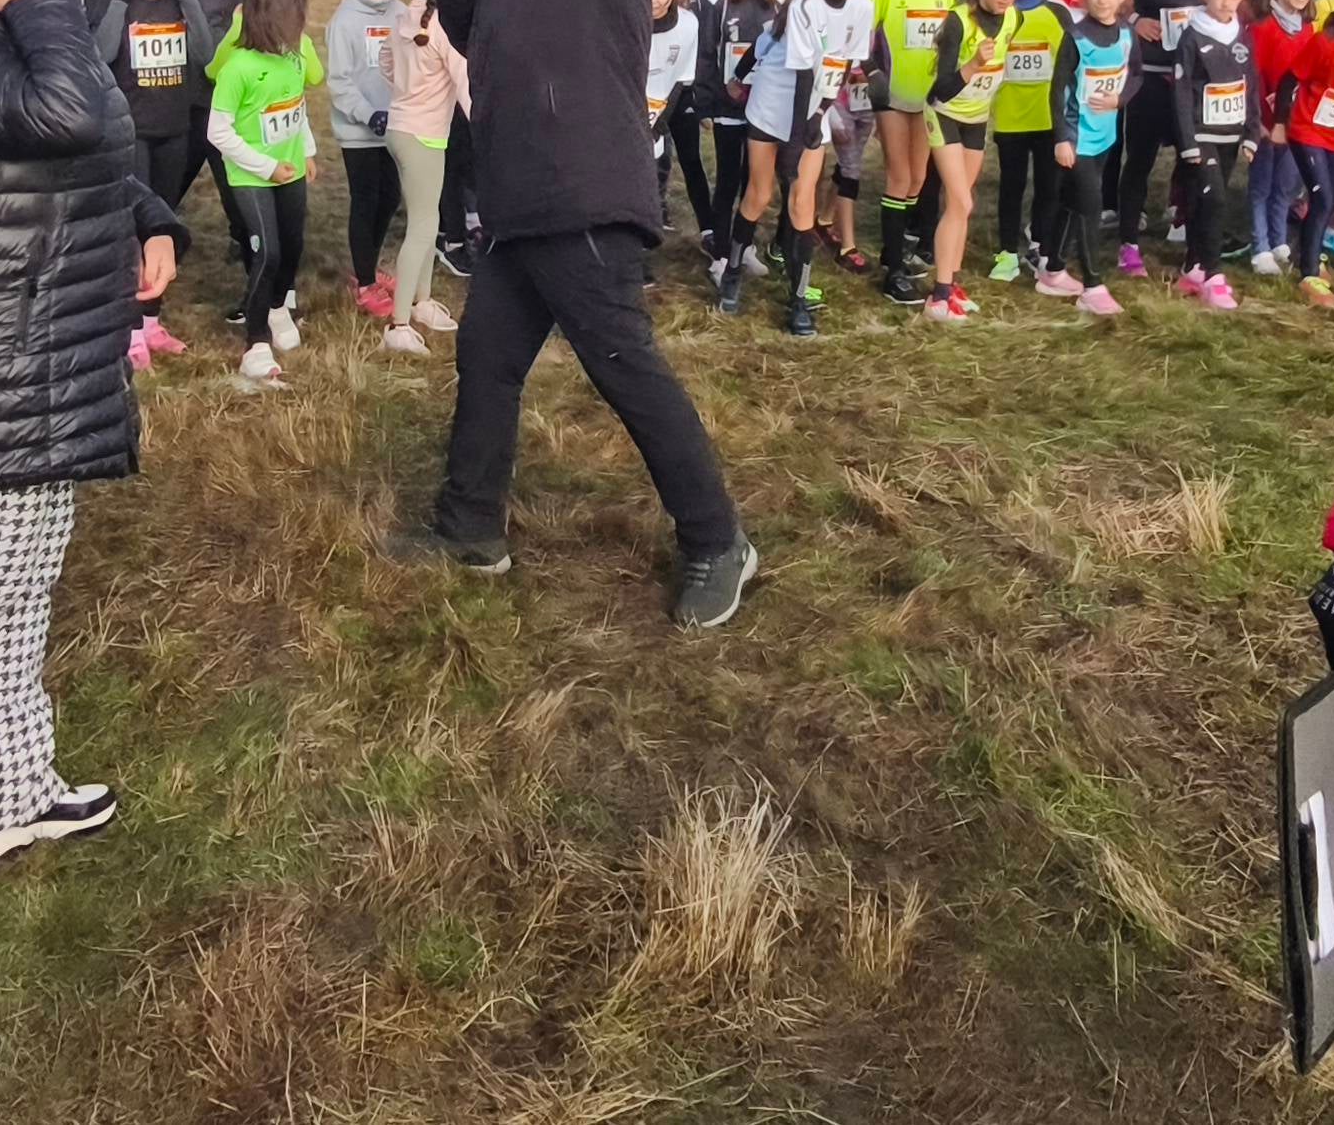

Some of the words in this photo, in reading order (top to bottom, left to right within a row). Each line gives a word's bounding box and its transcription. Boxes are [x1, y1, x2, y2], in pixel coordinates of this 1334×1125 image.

[138, 38, 183, 58] 1011
[1012, 54, 1043, 70] 289
[825, 71, 845, 87] 12
